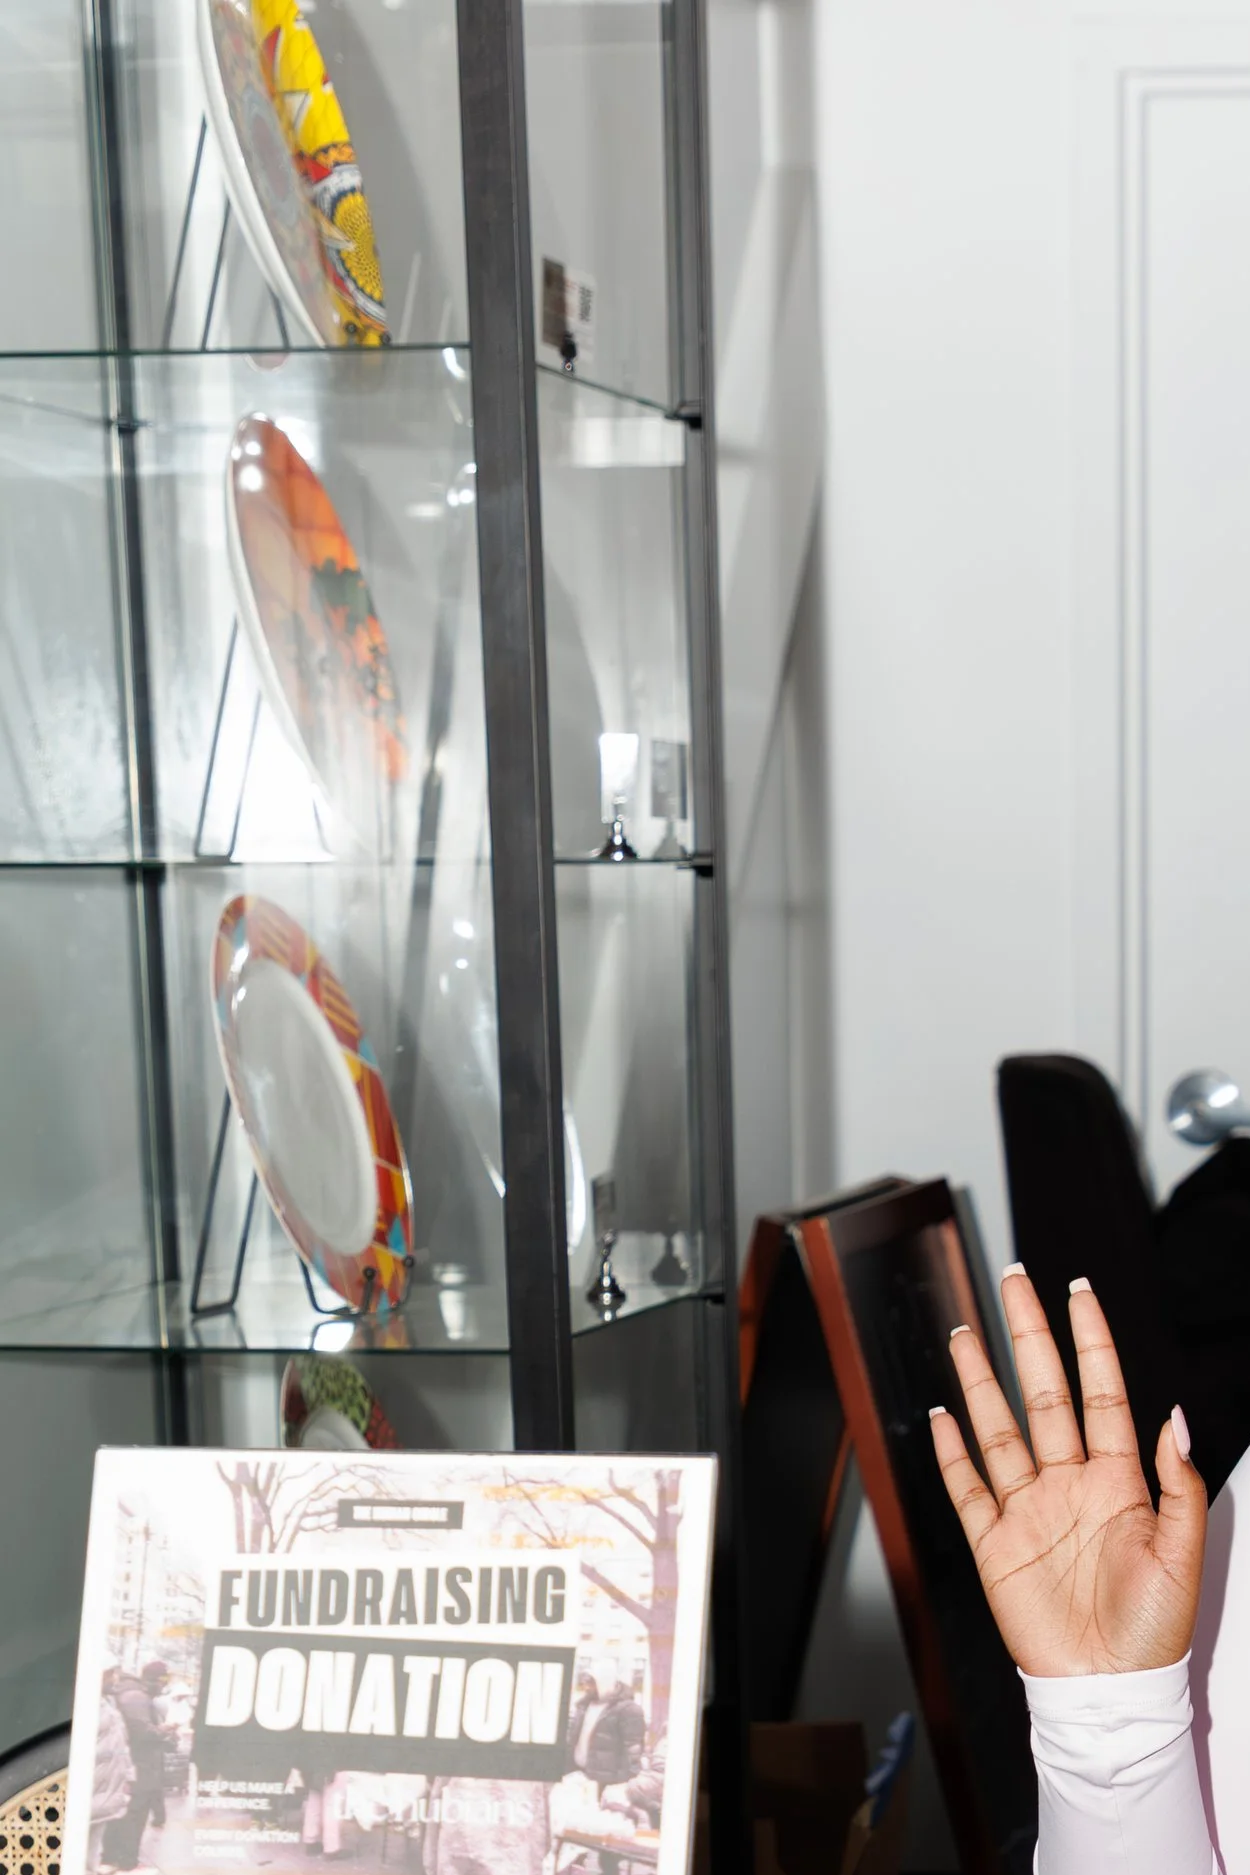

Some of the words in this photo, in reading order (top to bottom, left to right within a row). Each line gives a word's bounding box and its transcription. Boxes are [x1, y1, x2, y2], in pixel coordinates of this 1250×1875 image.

[217, 1566, 566, 1628] FUNDRAISING
[205, 1646, 565, 1745] DONATION
[198, 1780, 229, 1793] HELP
[230, 1781, 247, 1793] US
[248, 1782, 284, 1795] MAKE
